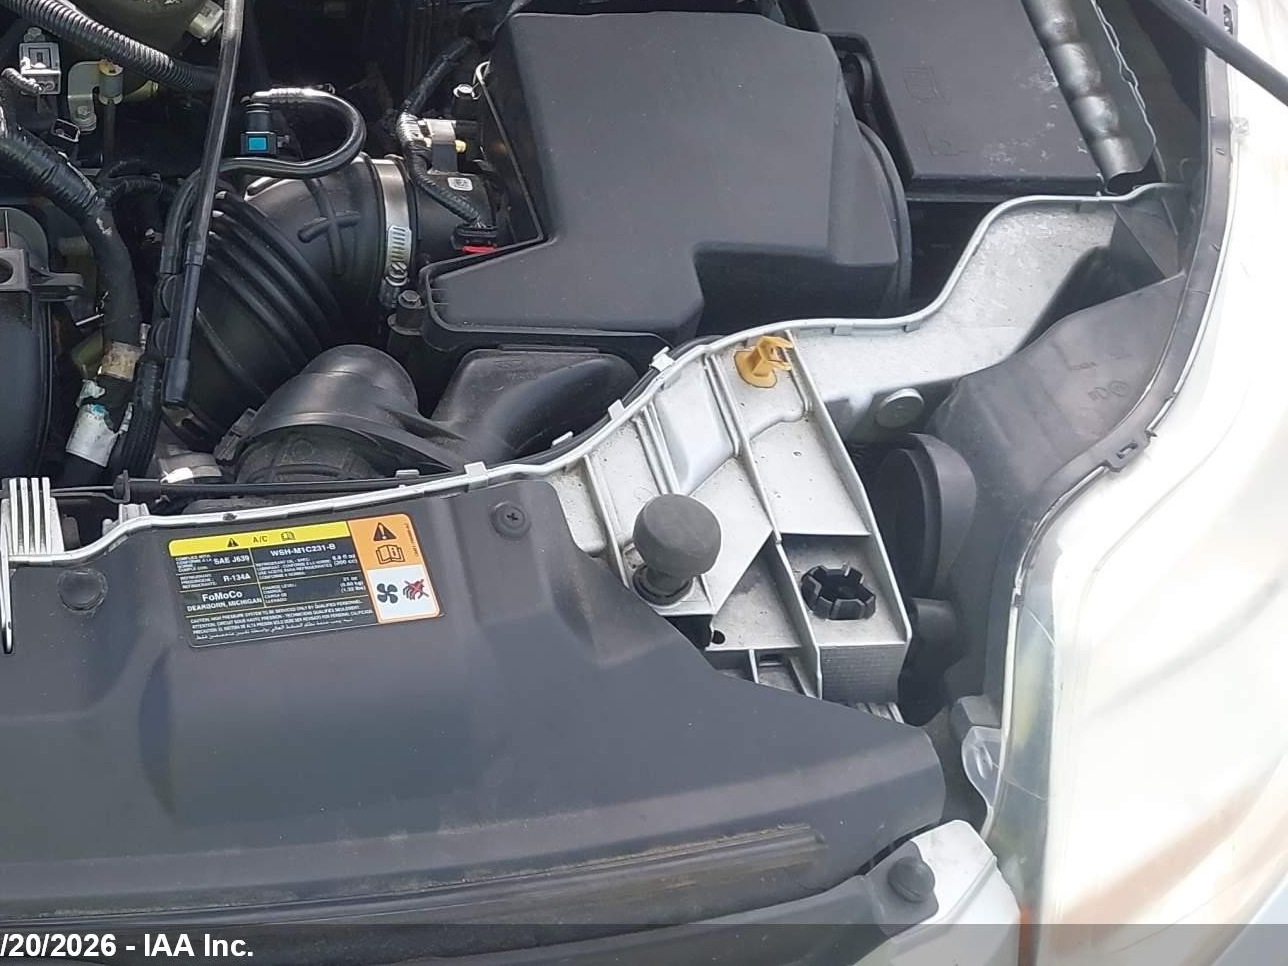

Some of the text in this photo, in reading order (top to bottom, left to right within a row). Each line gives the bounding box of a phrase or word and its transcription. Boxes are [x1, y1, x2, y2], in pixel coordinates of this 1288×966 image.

[270, 544, 337, 557] WSH-M1C231-B
[214, 555, 250, 565] SAE J639
[223, 573, 251, 582] R-134A
[202, 590, 243, 602] FoMoCo
[228, 598, 262, 607] MICHIGAN
